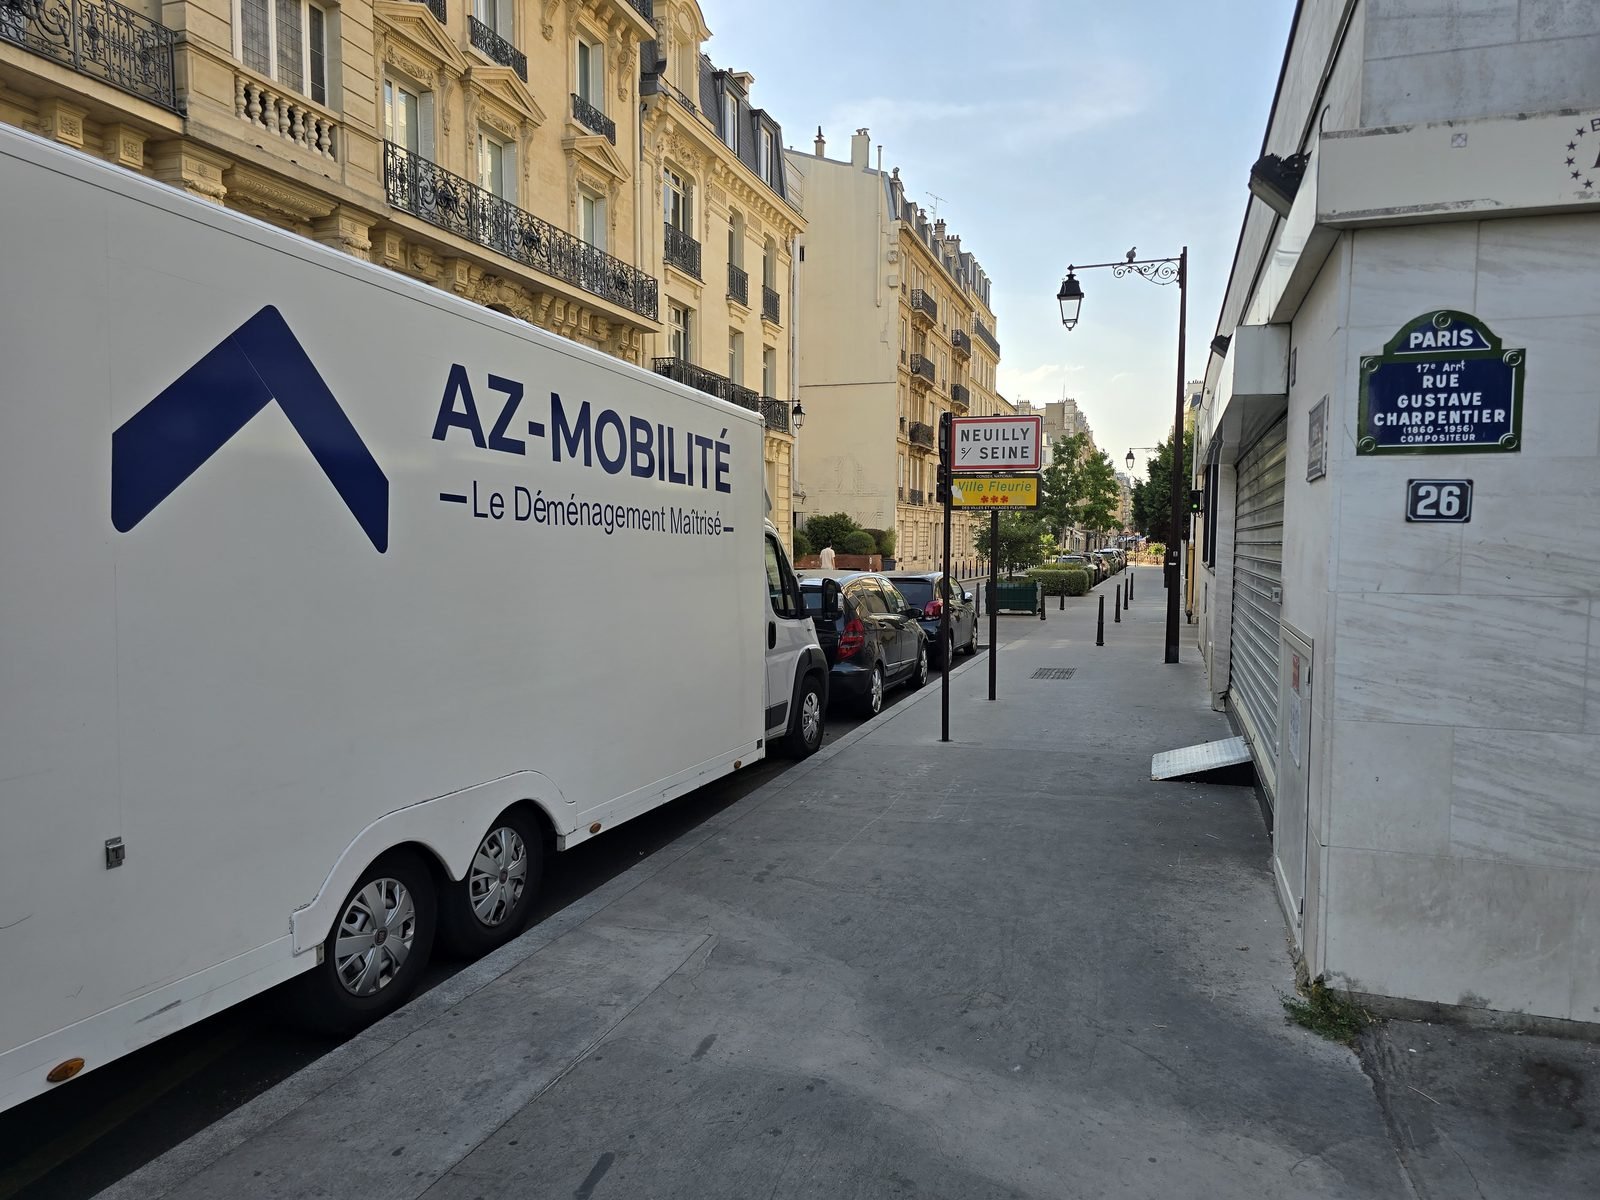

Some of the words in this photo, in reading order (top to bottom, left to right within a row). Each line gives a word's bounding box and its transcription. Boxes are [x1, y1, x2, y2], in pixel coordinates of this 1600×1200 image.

[1409, 328, 1474, 349] PARIS
[1422, 373, 1459, 389] RUE
[1397, 392, 1482, 409] GUSTAVE
[1373, 409, 1506, 426] CHARPENTIER
[432, 362, 731, 494] AZ-MOBILITÉ
[960, 427, 1030, 442] NEUILLY
[1400, 433, 1476, 443] COMPOSITEUR
[979, 446, 1029, 460] SEINE
[958, 481, 984, 492] Ville
[988, 480, 1032, 492] Fleurie
[473, 480, 505, 521] Le
[514, 485, 666, 536] Déménagement
[1416, 485, 1461, 517] 26
